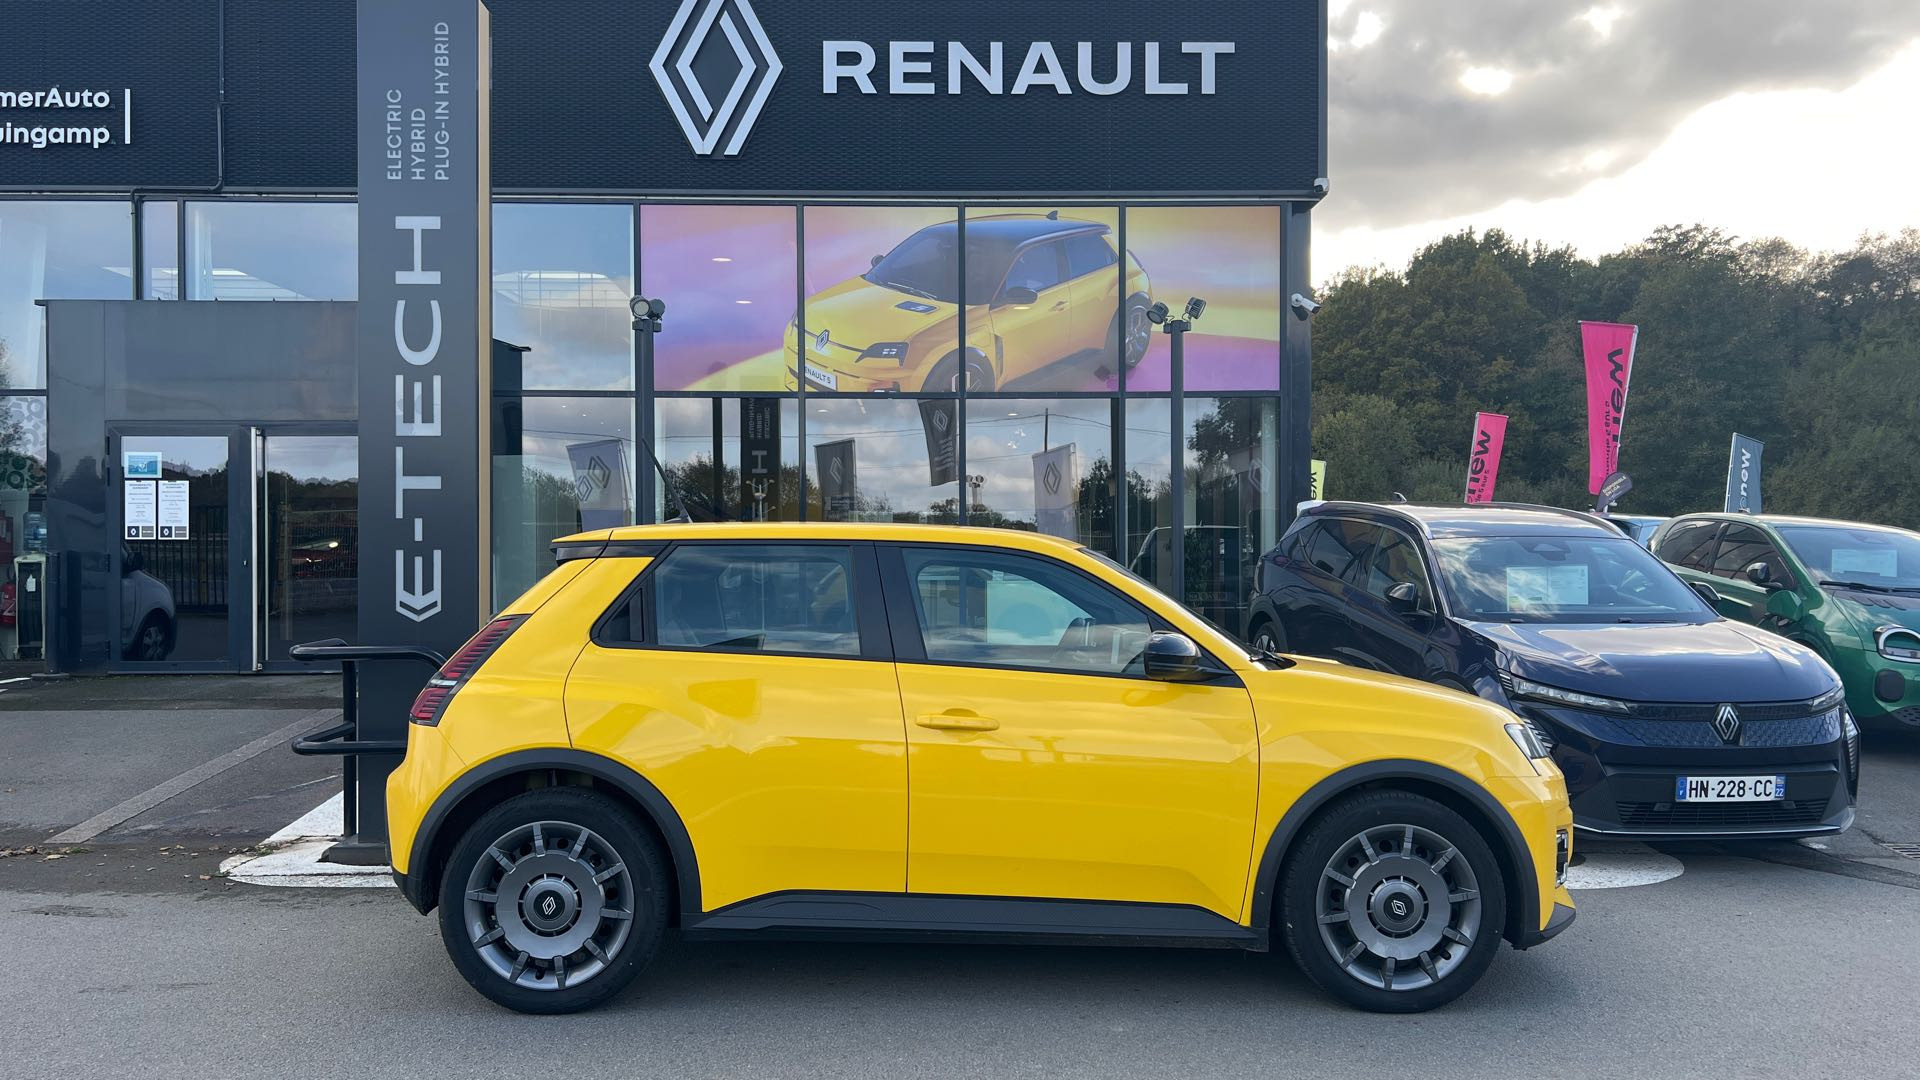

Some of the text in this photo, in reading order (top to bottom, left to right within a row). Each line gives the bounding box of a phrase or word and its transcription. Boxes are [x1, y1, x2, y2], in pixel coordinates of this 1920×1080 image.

[434, 22, 450, 180] PLUG-IN HYBRID
[823, 41, 1236, 95] RENAULT
[387, 89, 402, 180] ELECTRIC
[411, 108, 426, 180] HYBRID
[394, 216, 442, 622] E-TECH
[1688, 780, 1773, 798] HN-228-CC
[1775, 788, 1784, 797] 22
